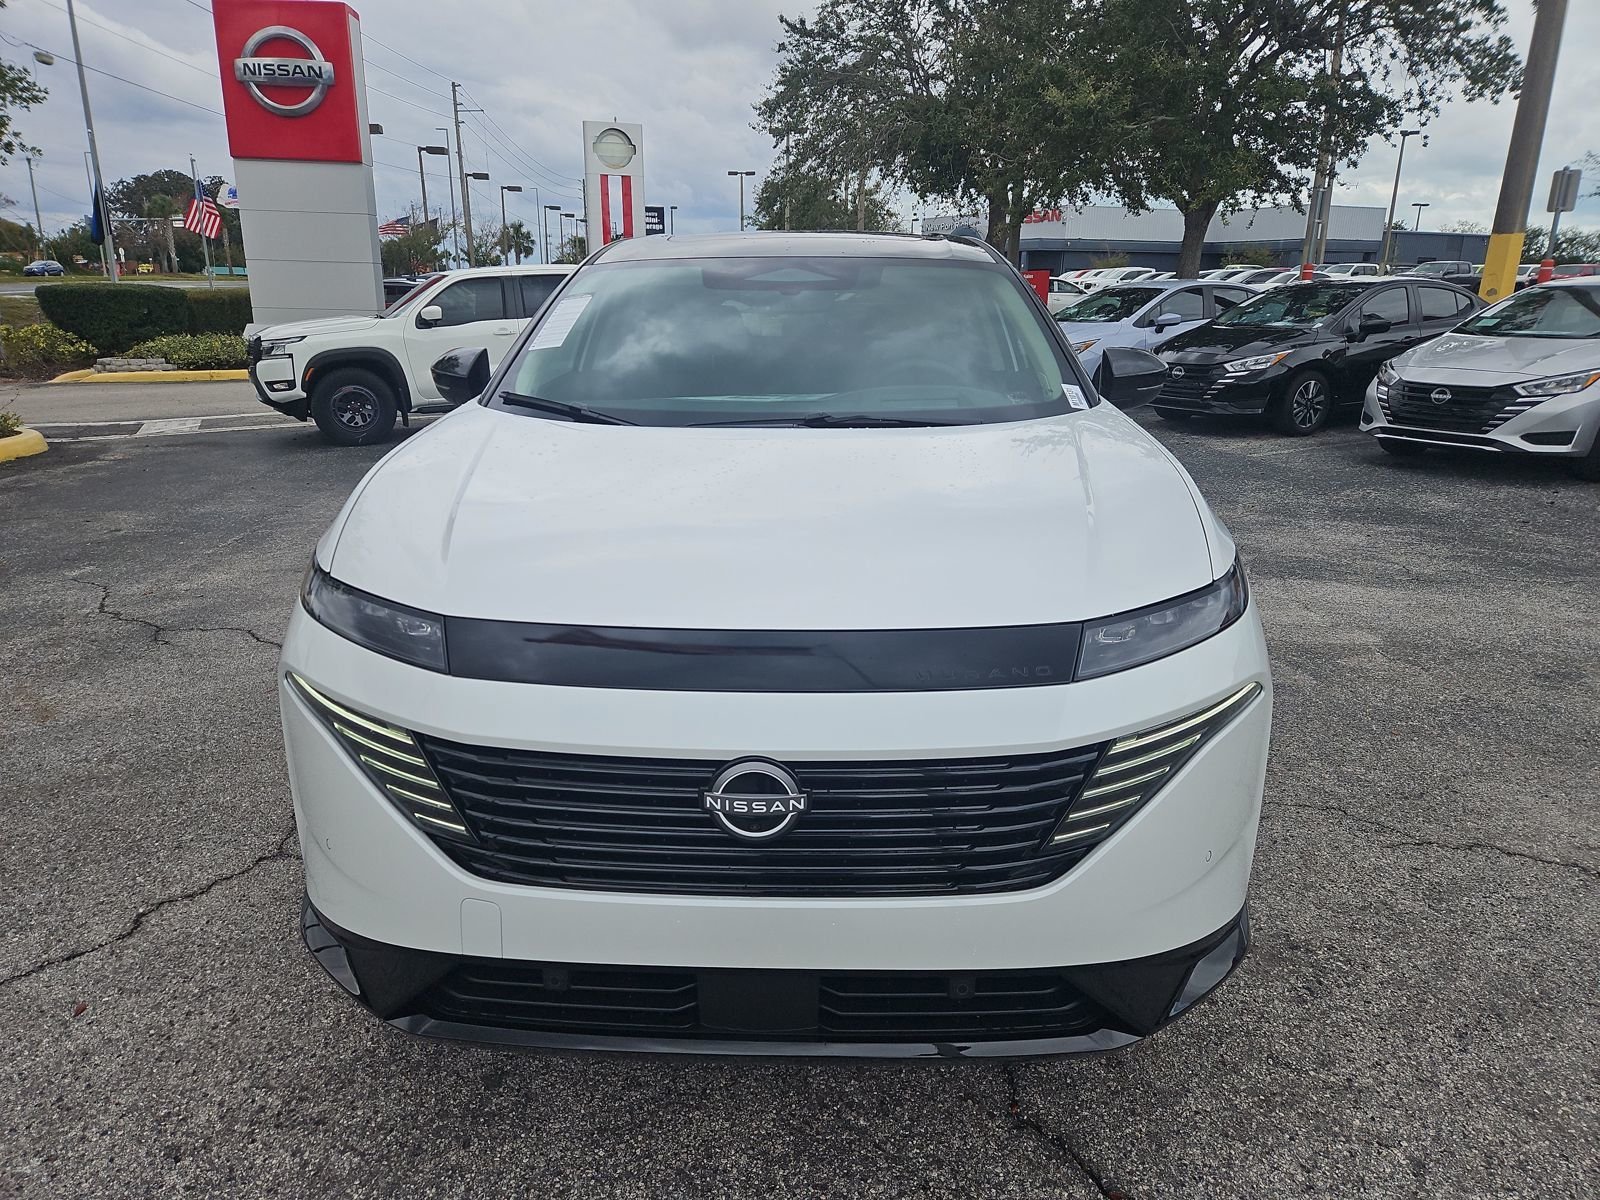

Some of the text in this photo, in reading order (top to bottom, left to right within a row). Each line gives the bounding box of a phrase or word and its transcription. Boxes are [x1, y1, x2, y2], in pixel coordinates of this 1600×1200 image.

[242, 62, 324, 79] NISSAN
[913, 665, 1052, 681] MURANO
[706, 796, 805, 813] NISSAN
